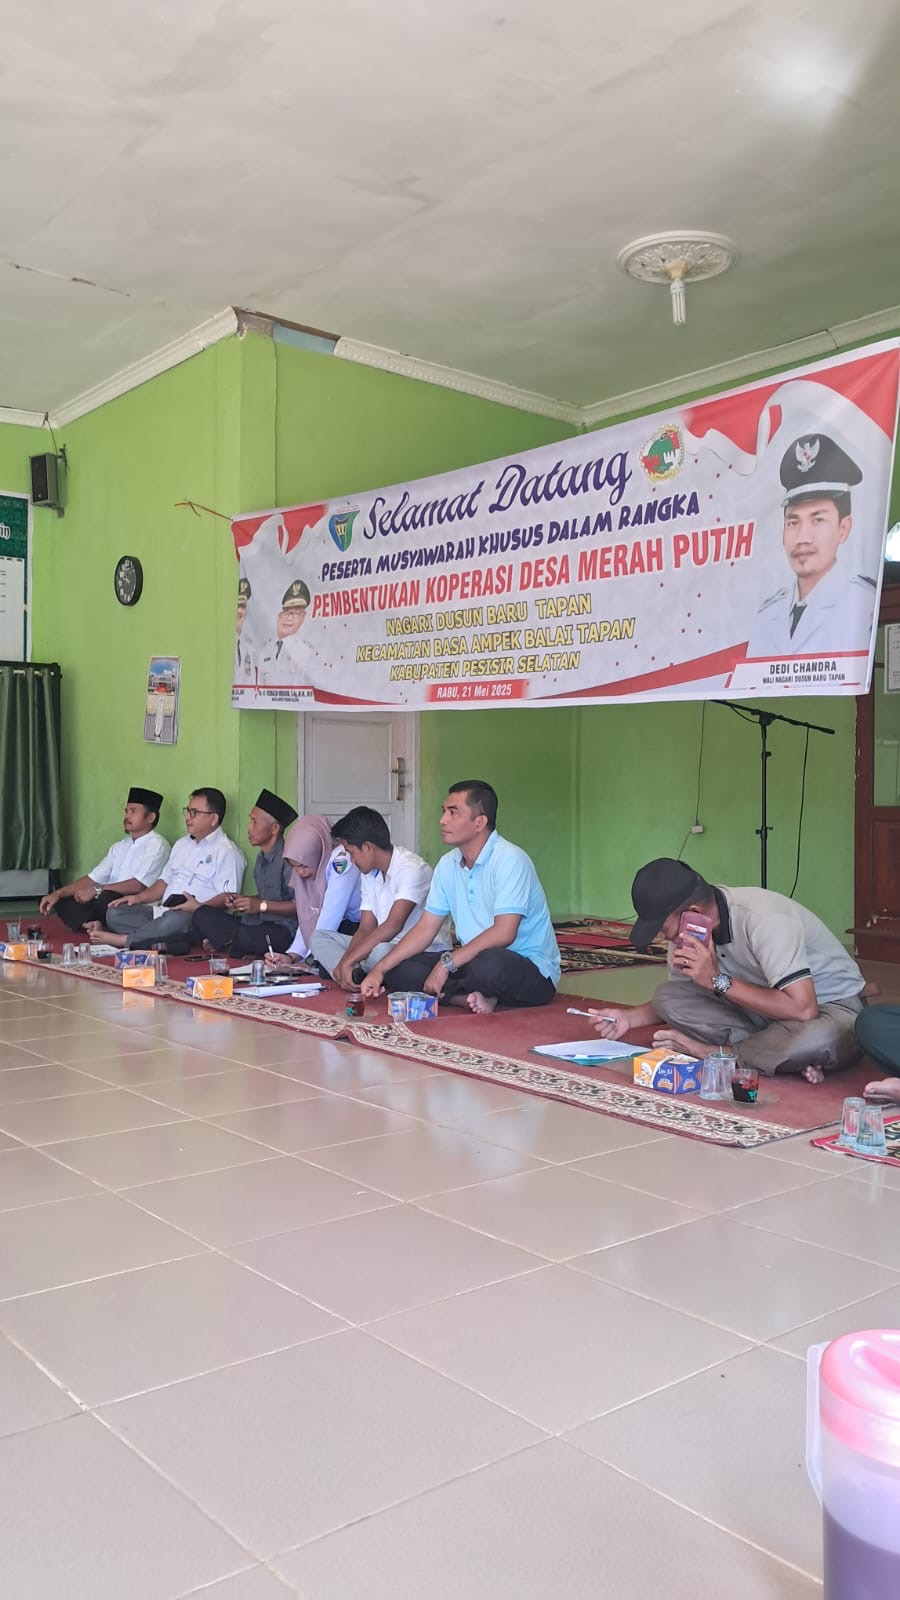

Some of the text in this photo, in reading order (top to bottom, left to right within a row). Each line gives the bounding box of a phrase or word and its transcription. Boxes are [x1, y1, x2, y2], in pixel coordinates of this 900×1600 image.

[363, 450, 632, 540] Selamat Datang
[322, 491, 700, 582] PESERTA MUSYAWARAH KHUSUS DALAM RANGKA
[311, 522, 754, 619] PEMBENTUKAN KOPERASI DESA MERAH PUTIH
[386, 593, 591, 636] NAGARI DUSUN BARU TAPAN
[356, 618, 635, 663] KECAMATAN BASA AMPEK BALAI TAPAN
[390, 651, 580, 681] KABUPATEN PESISIR SELATAN
[770, 660, 837, 675] DEDI CHANDRA
[829, 673, 846, 681] TAPAN
[437, 684, 512, 699] RABU, 21 Mei 2025
